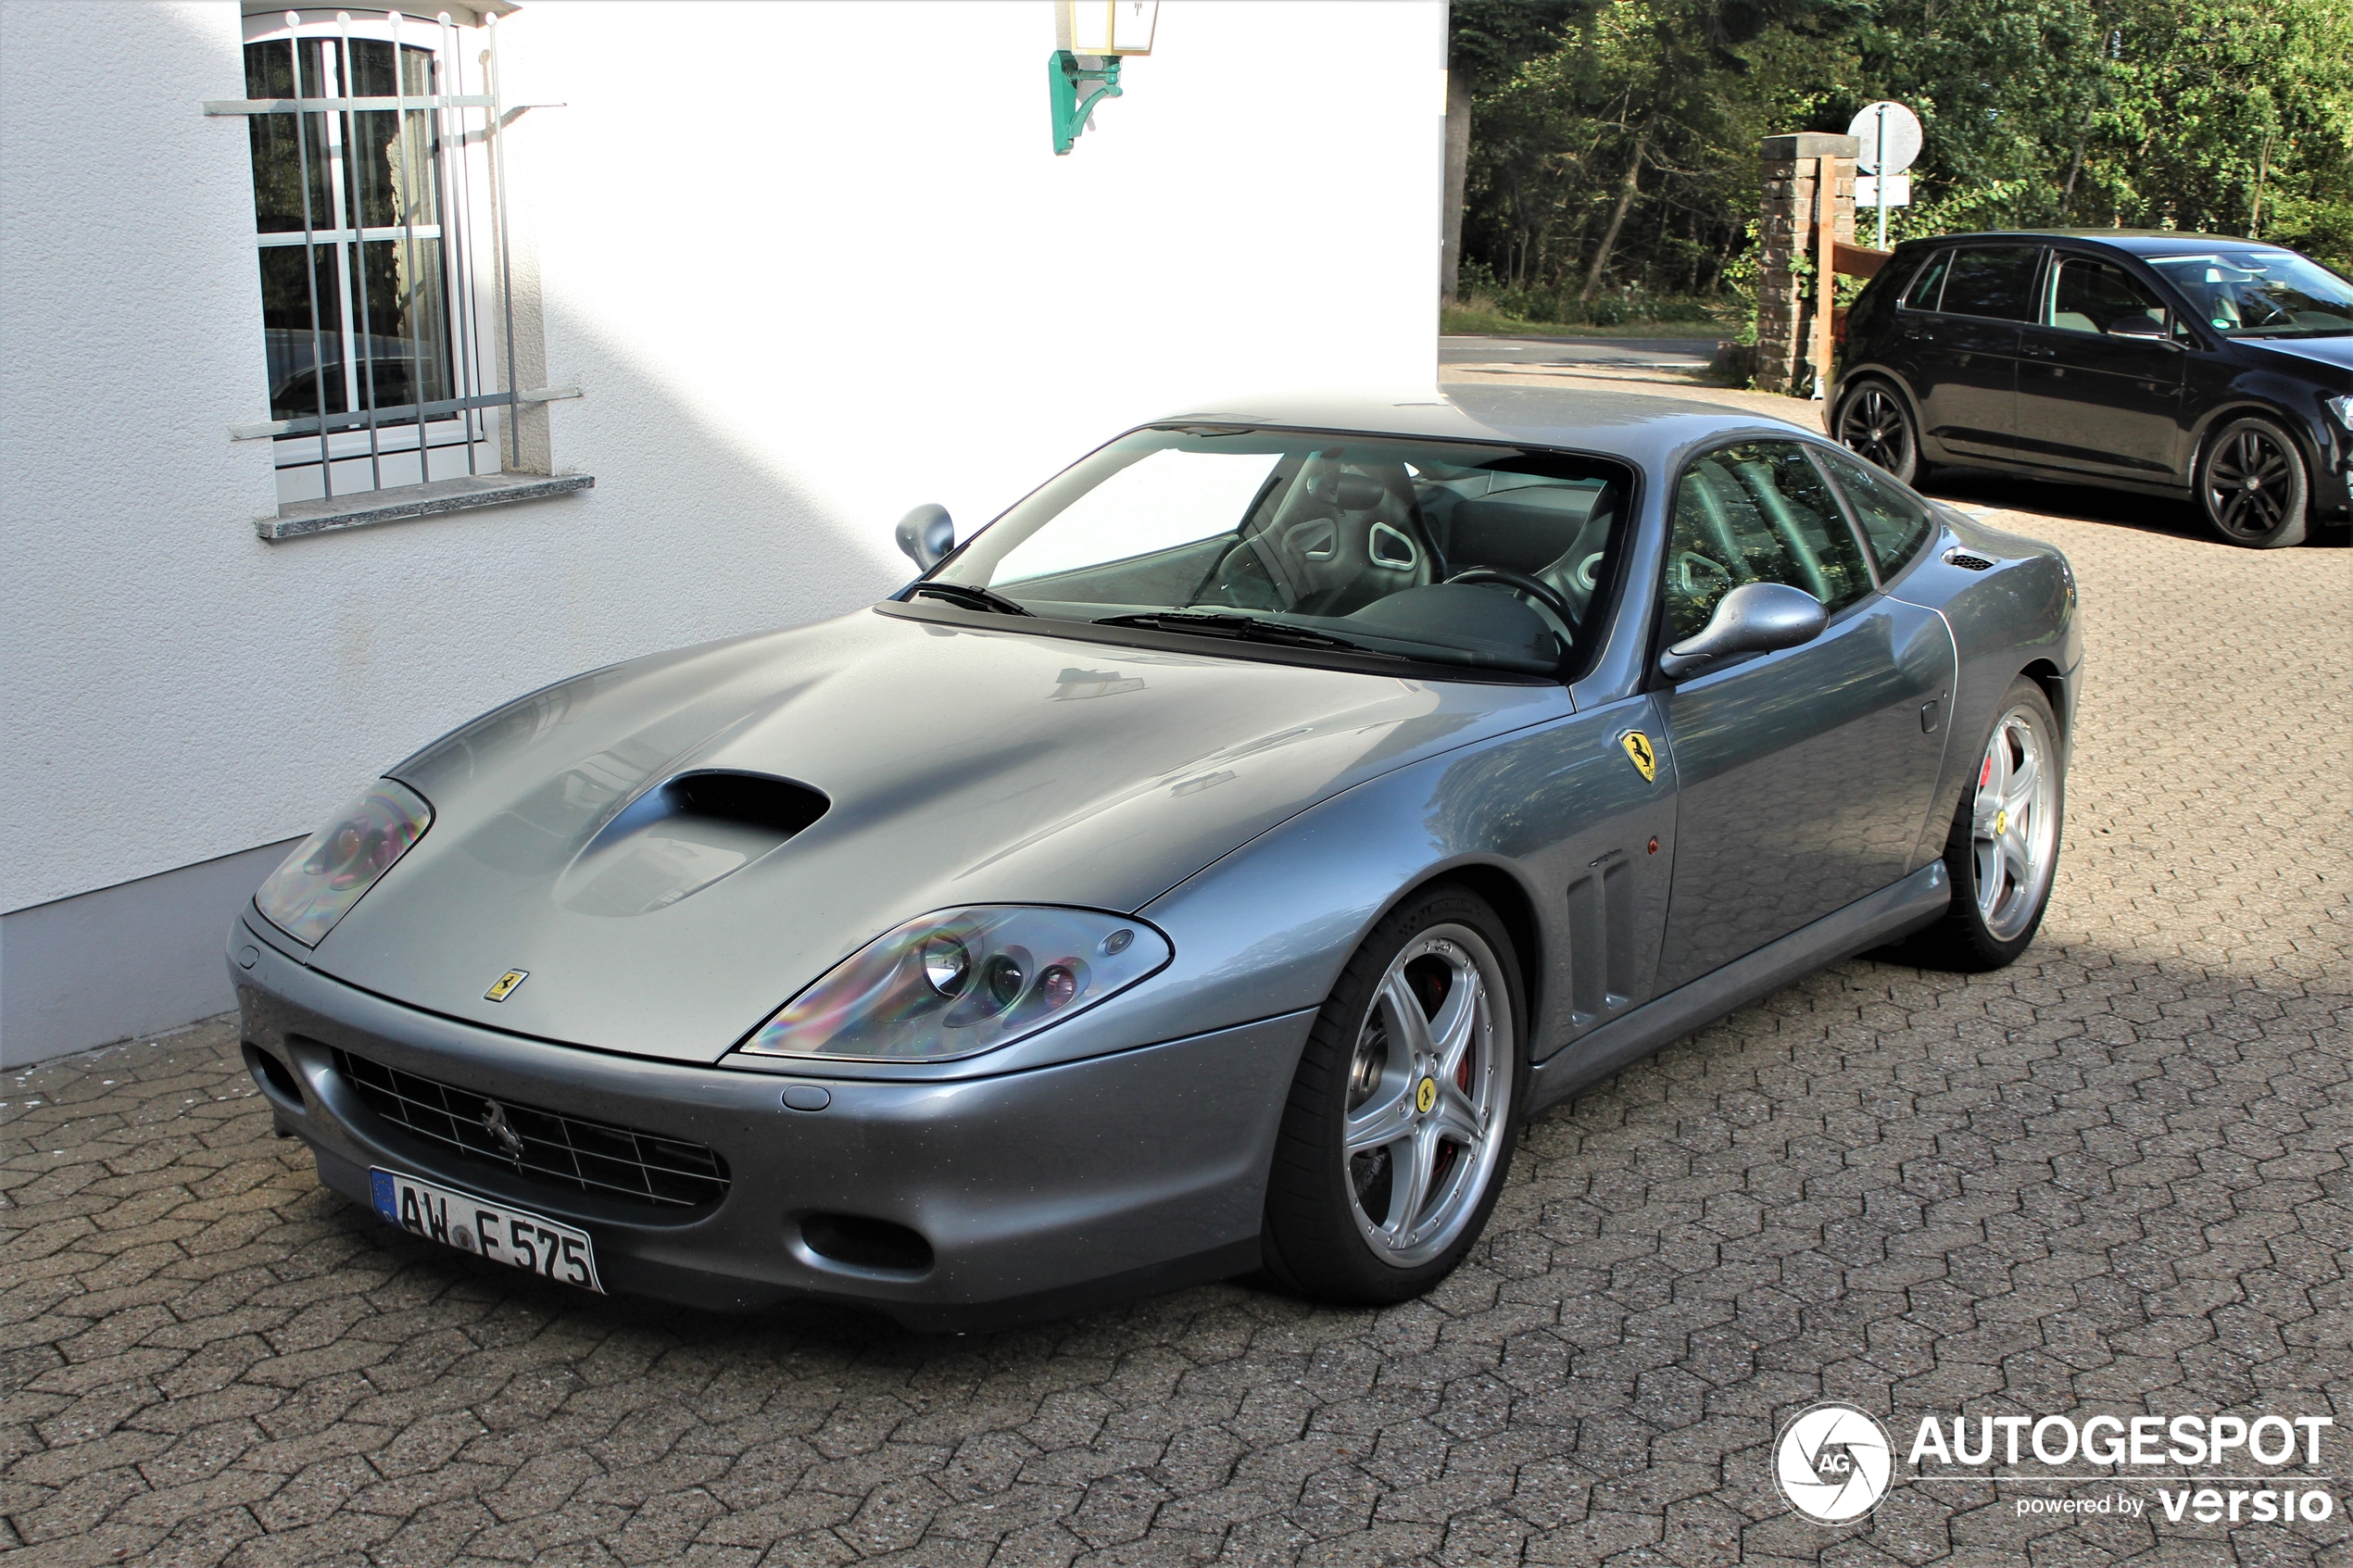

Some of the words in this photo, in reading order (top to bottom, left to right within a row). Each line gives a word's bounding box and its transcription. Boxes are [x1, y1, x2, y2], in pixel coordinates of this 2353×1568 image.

[383, 1210, 395, 1223] D
[402, 1185, 451, 1245] AW
[475, 1210, 500, 1258] F
[510, 1219, 592, 1287] 575
